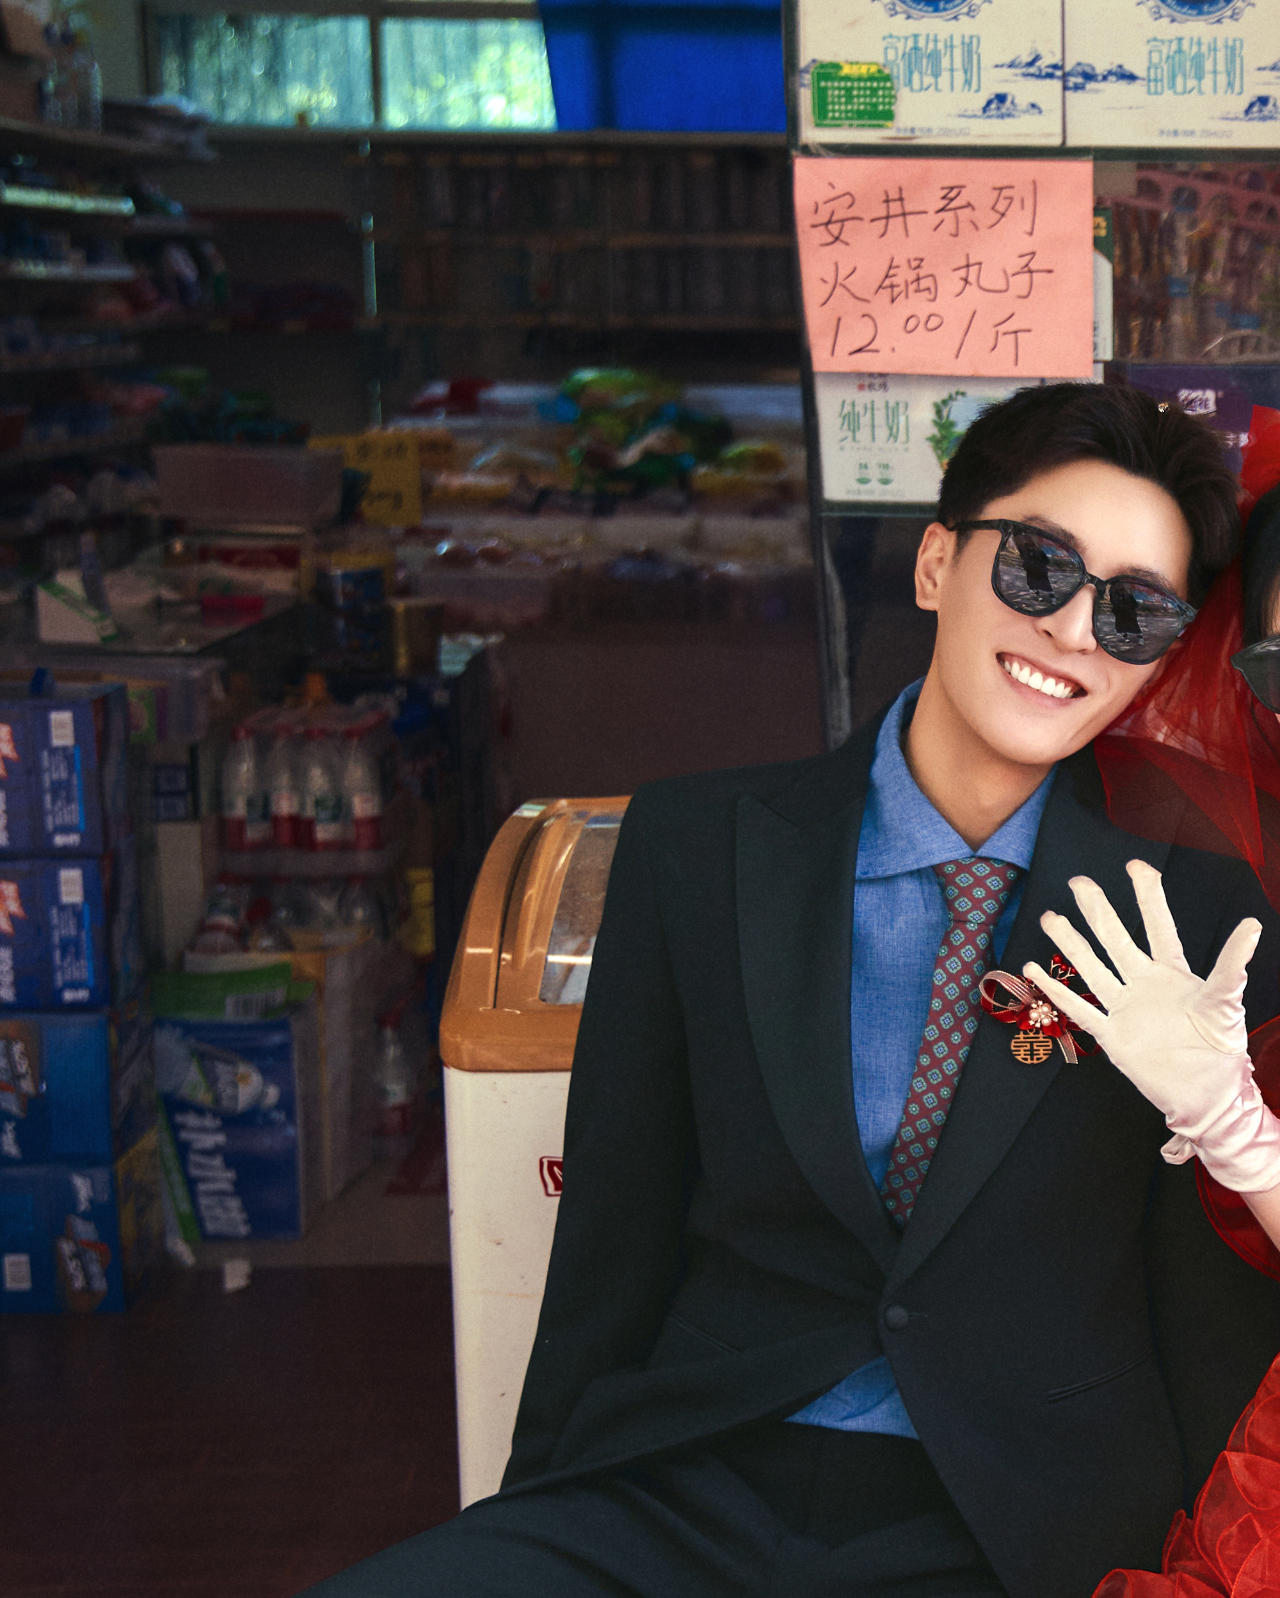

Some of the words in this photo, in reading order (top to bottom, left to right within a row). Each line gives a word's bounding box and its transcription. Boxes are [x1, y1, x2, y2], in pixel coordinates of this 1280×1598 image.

[1147, 37, 1244, 95] 富硒纯牛奶
[810, 180, 1037, 247] 安井系列
[820, 251, 1054, 307] 火锅丸子
[839, 399, 910, 444] 纯牛奶
